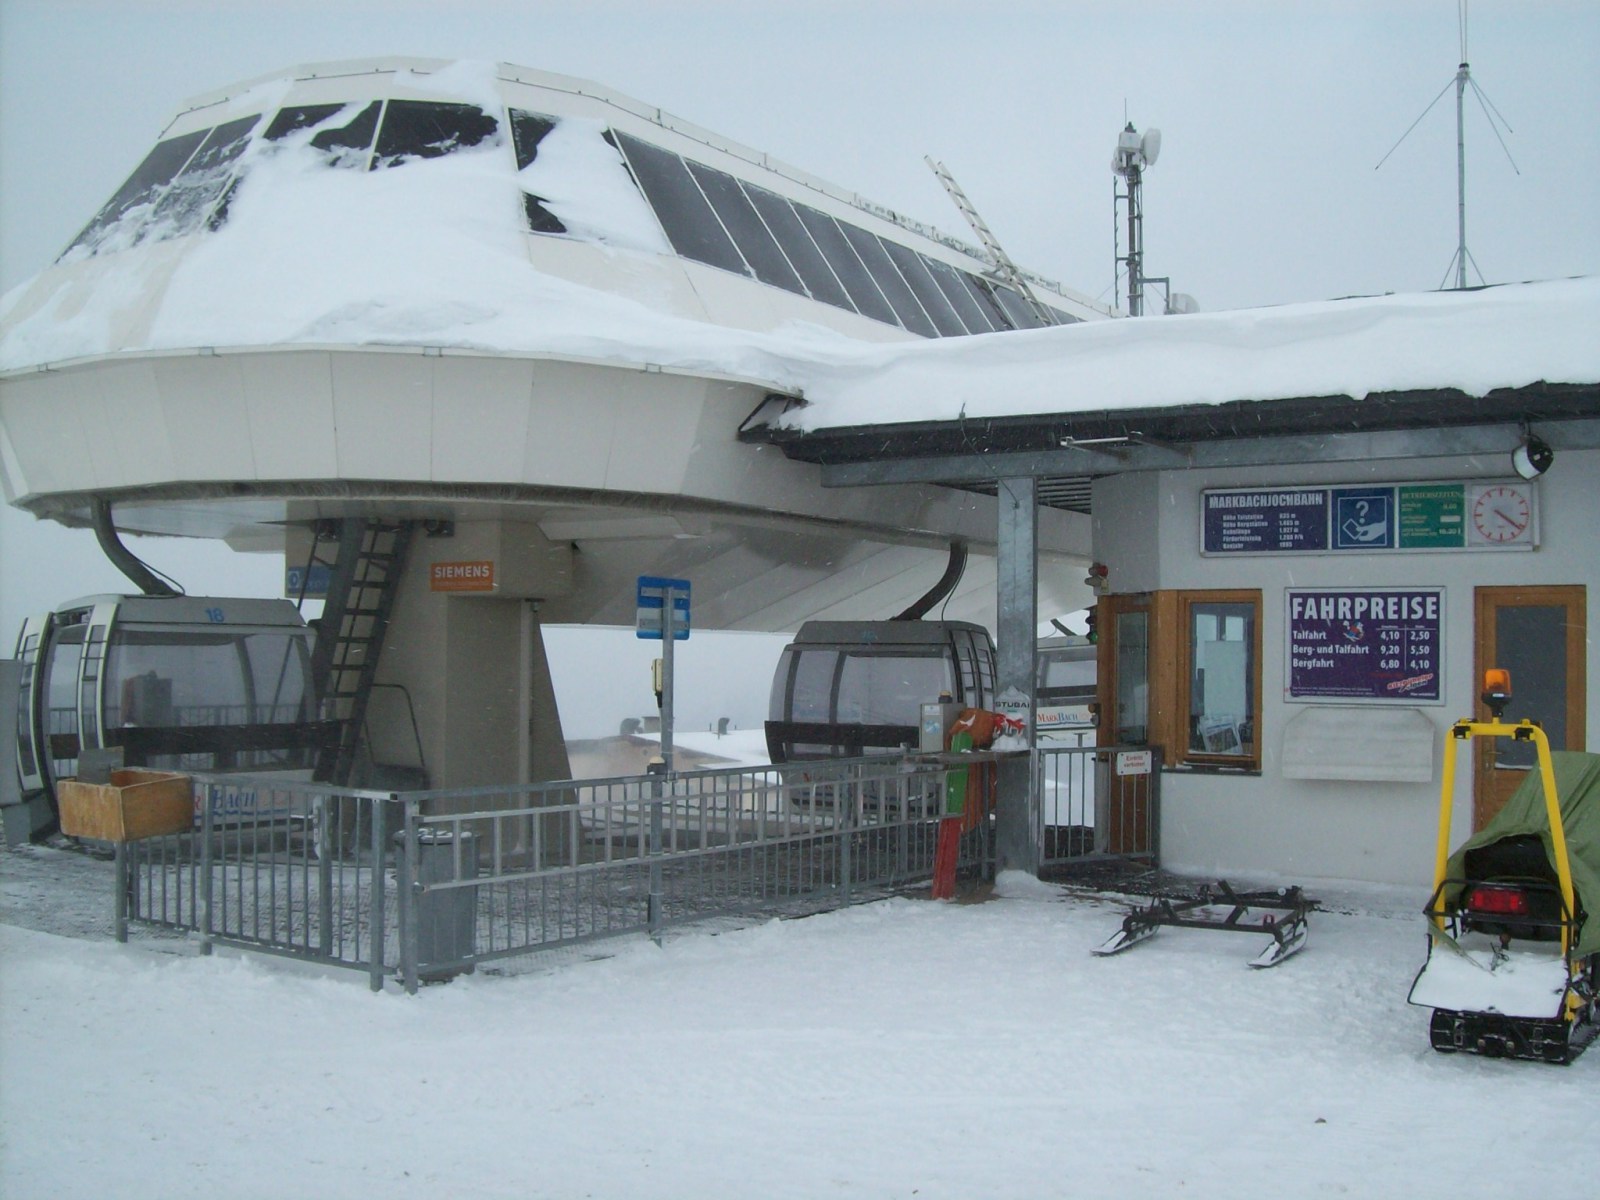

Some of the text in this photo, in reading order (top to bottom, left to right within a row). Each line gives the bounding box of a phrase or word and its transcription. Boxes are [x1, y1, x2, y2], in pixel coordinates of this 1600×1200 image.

[1209, 492, 1323, 509] MARKBACHJOCHBAHN
[434, 565, 490, 578] SIEMENS
[1292, 596, 1438, 620] FAHRPREISE
[205, 607, 225, 623] 18
[1292, 630, 1430, 641] Talfahrt 4,10 2,50
[1292, 644, 1430, 656] Berg- und Talfahrt 9,20 5,50
[1292, 658, 1430, 670] Bergfahrt 6,80 4,10
[995, 701, 1030, 709] STUBAI
